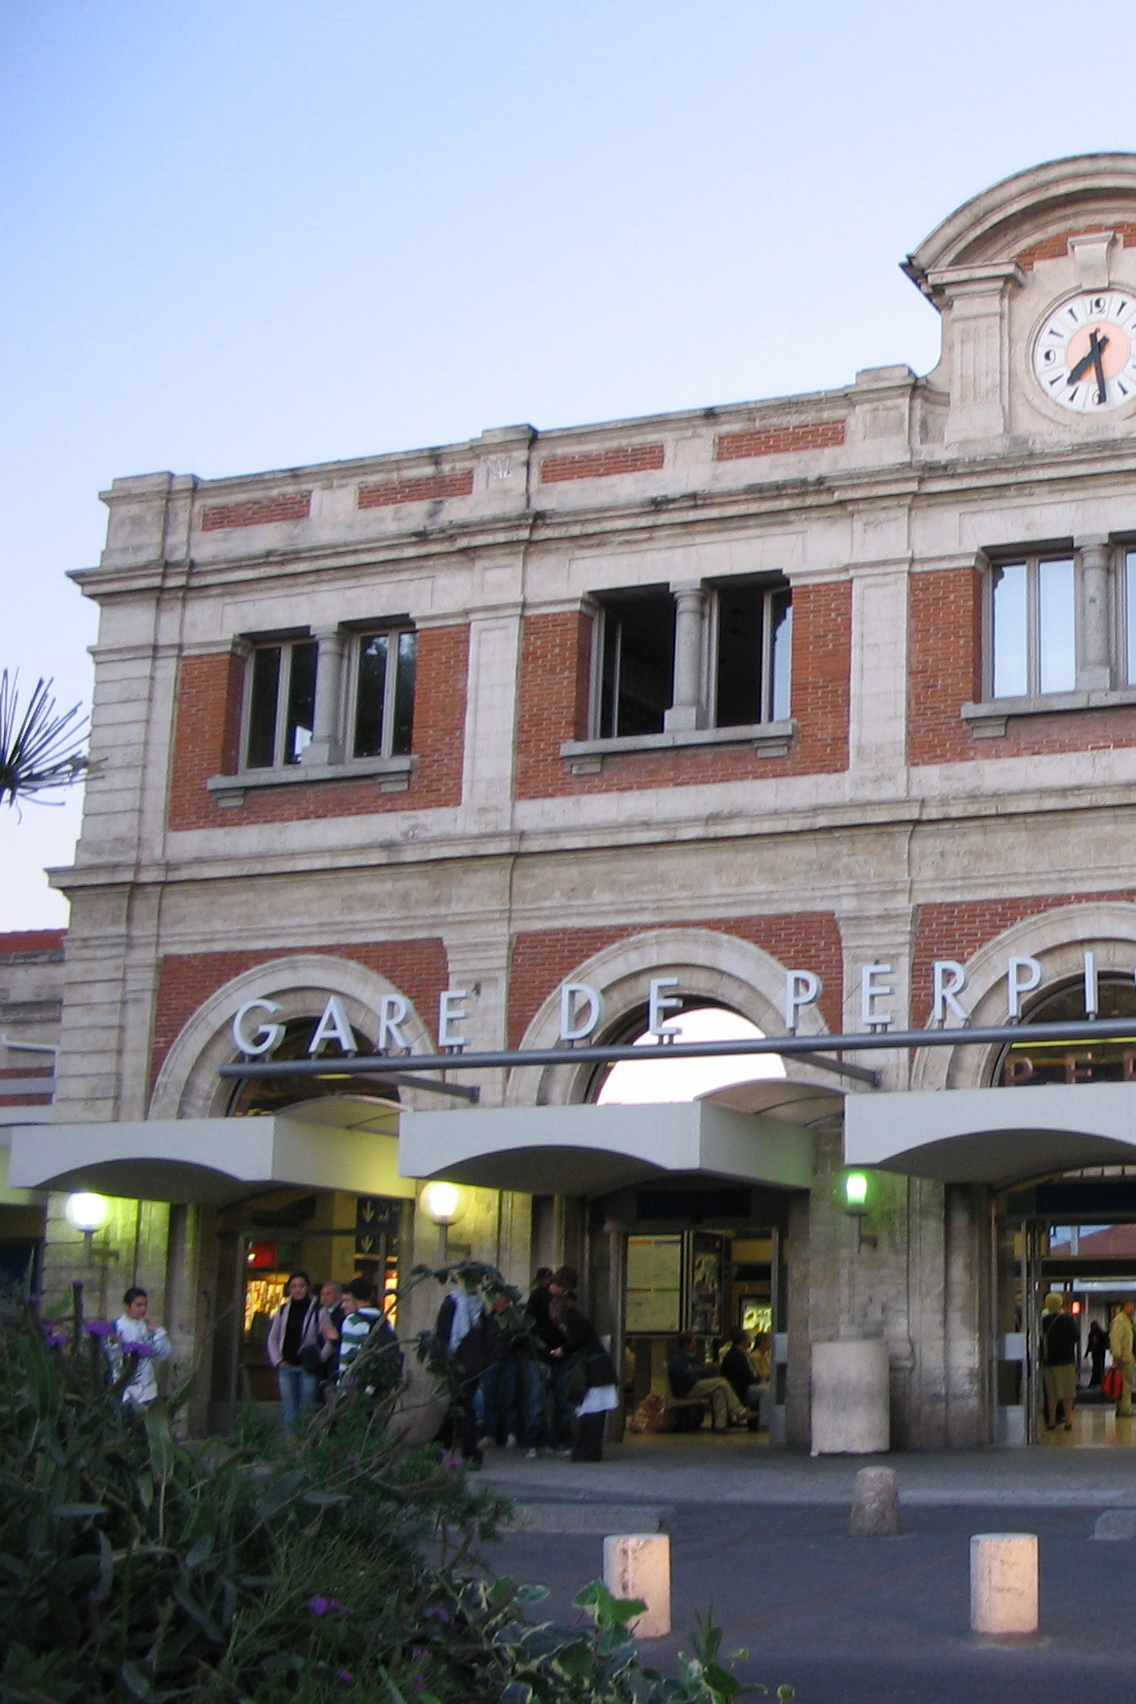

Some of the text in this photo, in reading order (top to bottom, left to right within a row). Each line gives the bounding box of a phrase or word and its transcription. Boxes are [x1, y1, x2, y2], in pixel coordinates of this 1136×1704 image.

[1089, 297, 1107, 315] 12
[1044, 349, 1057, 367] 9
[232, 989, 470, 1056] GARE
[560, 977, 683, 1041] DE
